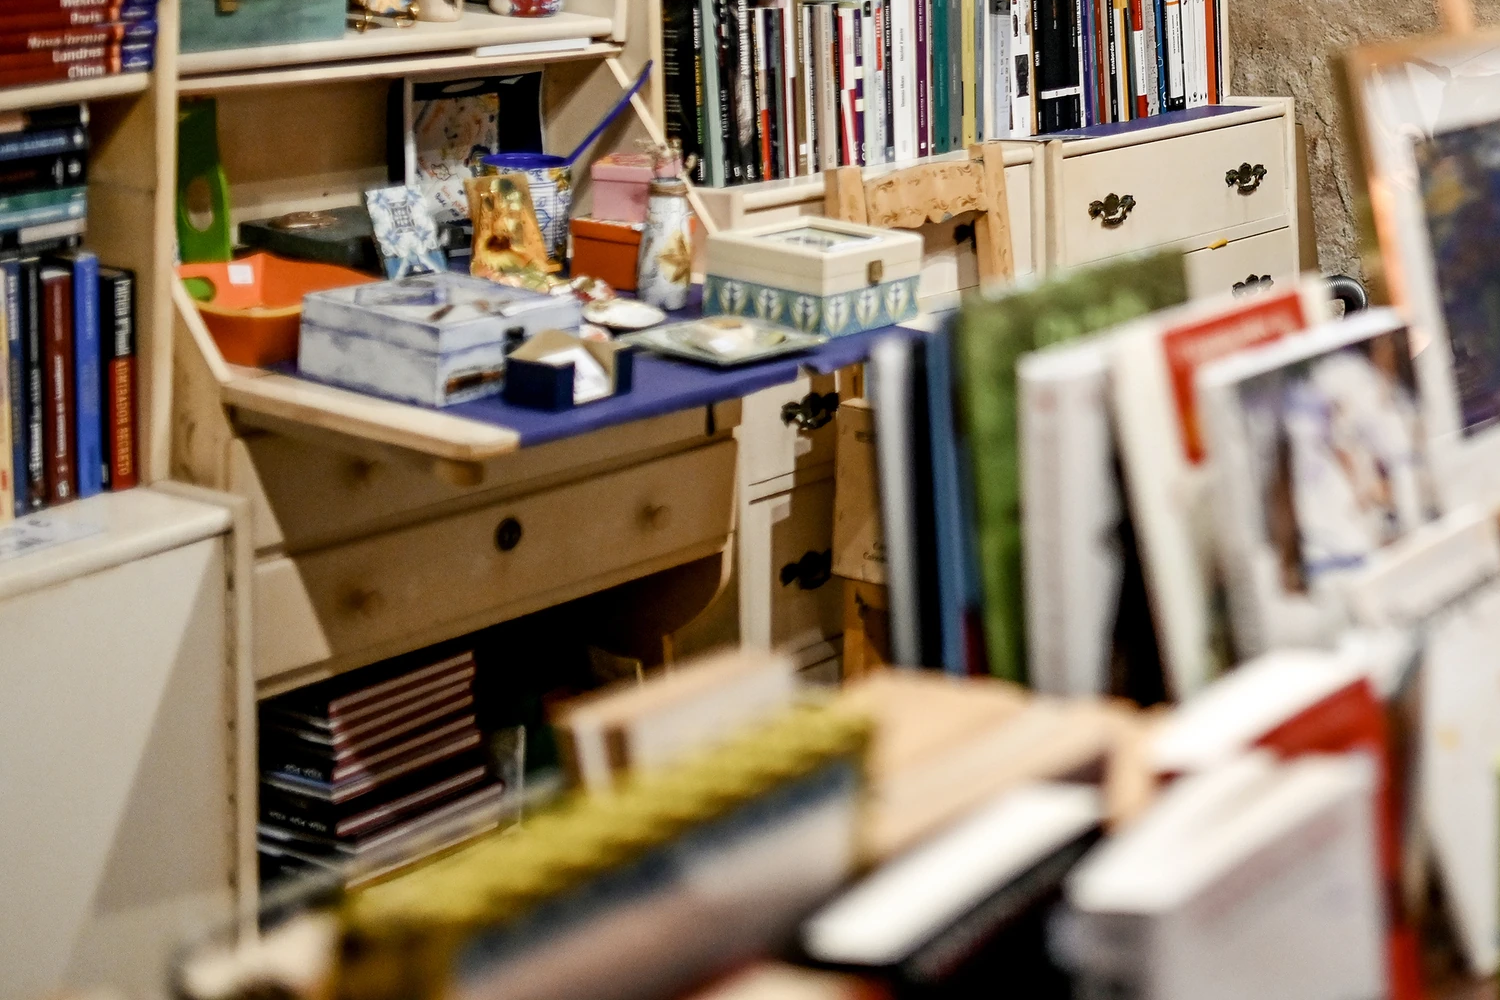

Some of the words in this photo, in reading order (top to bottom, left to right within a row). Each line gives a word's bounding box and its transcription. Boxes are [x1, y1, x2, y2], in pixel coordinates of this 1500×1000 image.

[70, 11, 102, 25] Paris
[737, 0, 747, 32] DONNA
[52, 48, 105, 62] Londres
[738, 33, 748, 76] HARAWAY
[68, 65, 105, 78] China
[115, 361, 130, 424] ADMIRADOR
[117, 428, 130, 476] SECRETO
